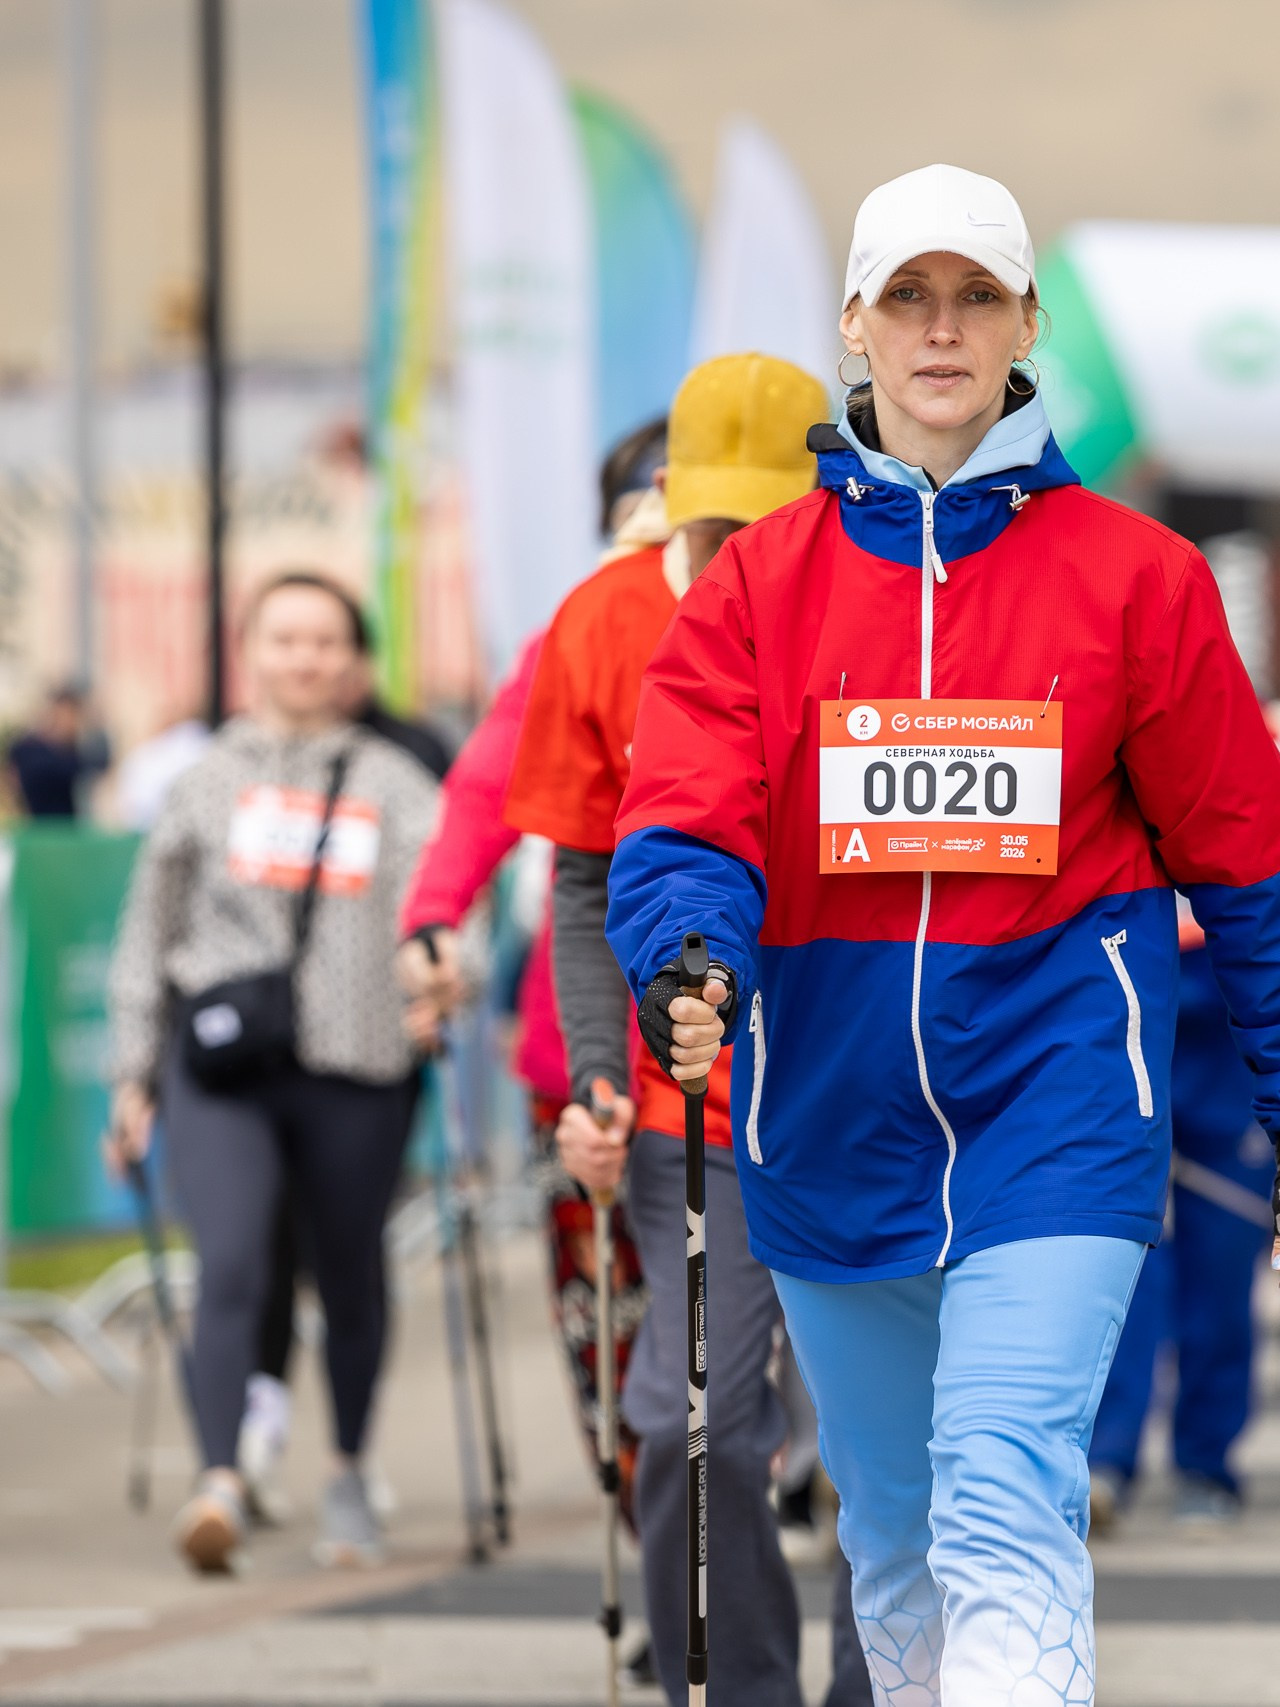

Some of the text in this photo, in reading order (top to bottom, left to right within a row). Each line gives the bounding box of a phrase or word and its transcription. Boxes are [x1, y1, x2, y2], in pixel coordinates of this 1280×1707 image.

[859, 714, 868, 728] 2
[914, 715, 1034, 731] СБЕР МОБАЙЛ
[885, 748, 995, 759] СЕВЕРНАЯ ХОДЬБА
[864, 760, 1018, 817] 0020
[1000, 835, 1028, 846] 30.05
[1000, 847, 1025, 858] 2026
[698, 1343, 706, 1370] ECOS
[698, 1457, 707, 1563] NORDIC WALKING POLE
